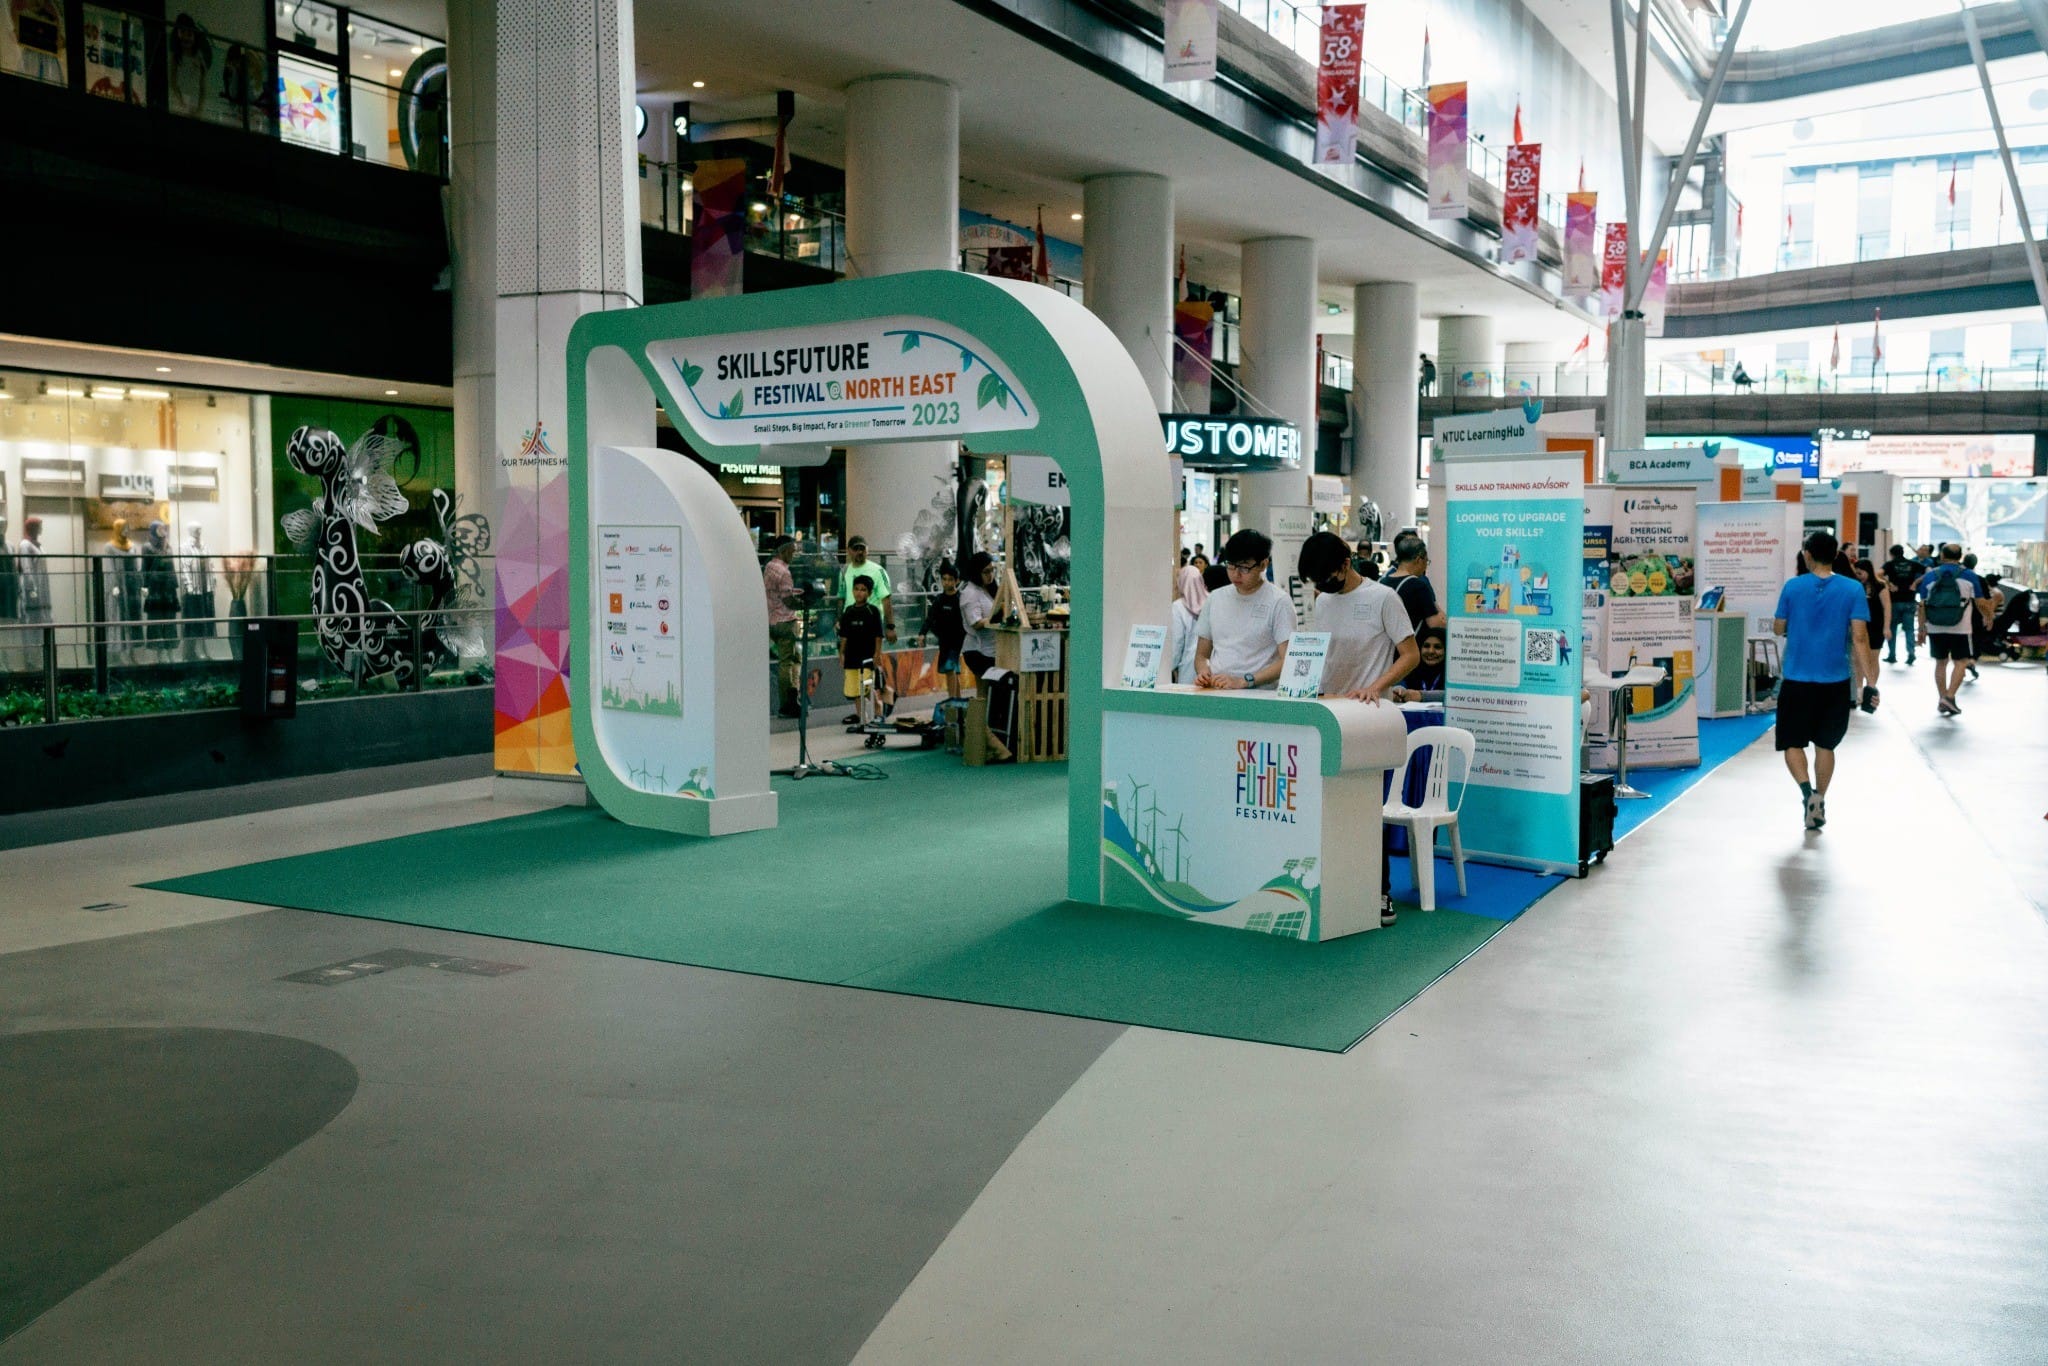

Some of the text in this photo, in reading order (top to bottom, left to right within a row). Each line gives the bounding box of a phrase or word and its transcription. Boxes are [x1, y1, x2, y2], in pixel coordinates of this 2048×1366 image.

[675, 116, 687, 135] 2
[717, 343, 870, 380] SKILLSFUTURE
[754, 382, 825, 406] FESTIVAL
[845, 377, 905, 400] NORTH
[910, 372, 957, 396] EAST
[912, 401, 960, 426] 2023
[754, 424, 771, 433] Small
[772, 422, 791, 434] Steps,
[792, 422, 802, 432] Big
[803, 421, 826, 431] Impact,
[827, 420, 838, 429] For
[844, 419, 871, 428] Greener
[872, 418, 906, 428] Tomorrow
[1442, 424, 1525, 444] NTUC LearningHub
[501, 458, 518, 467] OUR
[519, 457, 557, 466] TAMPINES
[1630, 460, 1691, 471] BCA Academy
[1455, 477, 1570, 492] SKILLS AND TRAINING ADVISORY
[1637, 503, 1679, 512] LearningHub
[1456, 512, 1567, 523] LOOKING TO UPGRADE
[1475, 527, 1544, 537] YOUR SKILLS?
[1630, 527, 1672, 535] EMERGING
[1613, 535, 1689, 544] AGRI-TECH SECTOR
[1754, 538, 1779, 546] Growth
[1742, 547, 1773, 555] Academy
[1237, 740, 1298, 778] SKILLS
[1236, 765, 1297, 811] FUTURE
[1236, 807, 1296, 824] FESTIVAL
